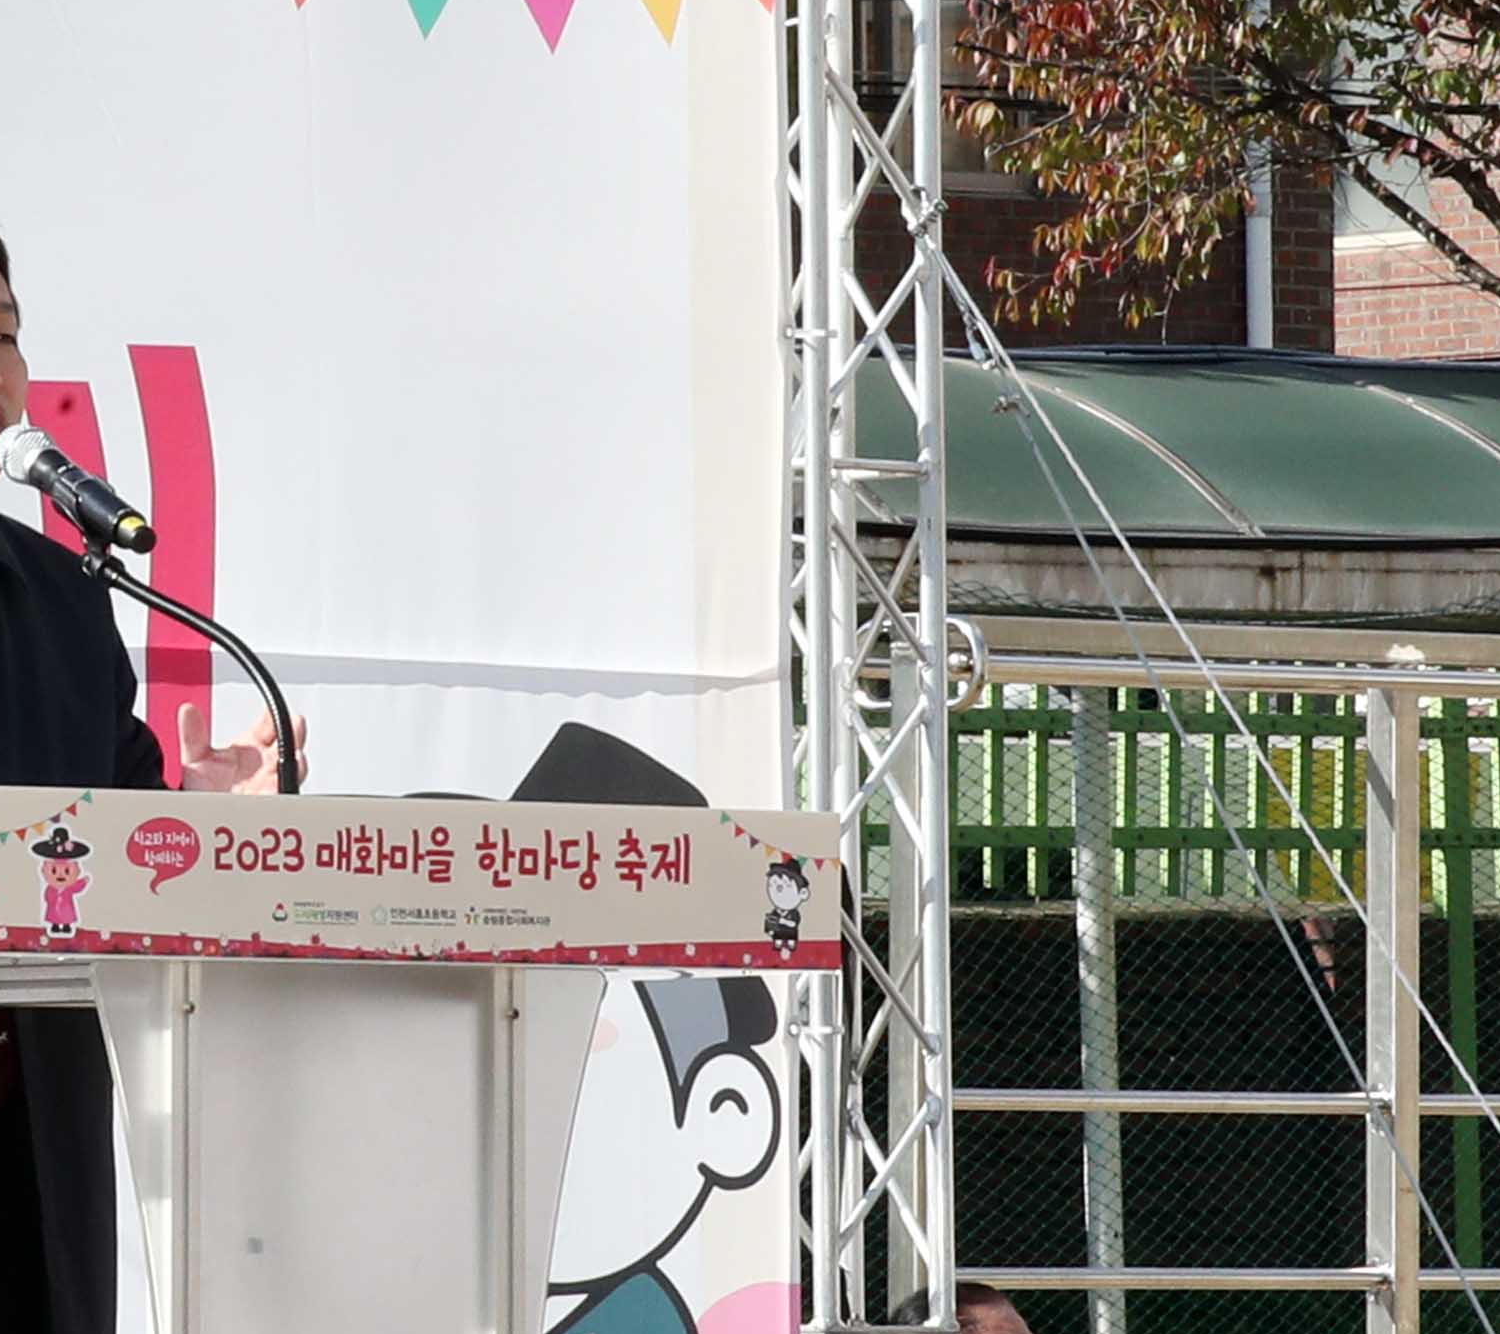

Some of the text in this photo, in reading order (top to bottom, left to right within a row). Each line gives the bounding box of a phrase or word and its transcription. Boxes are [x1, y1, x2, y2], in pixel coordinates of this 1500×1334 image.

[215, 824, 690, 891] 2023 매화마을 한마당 축제
